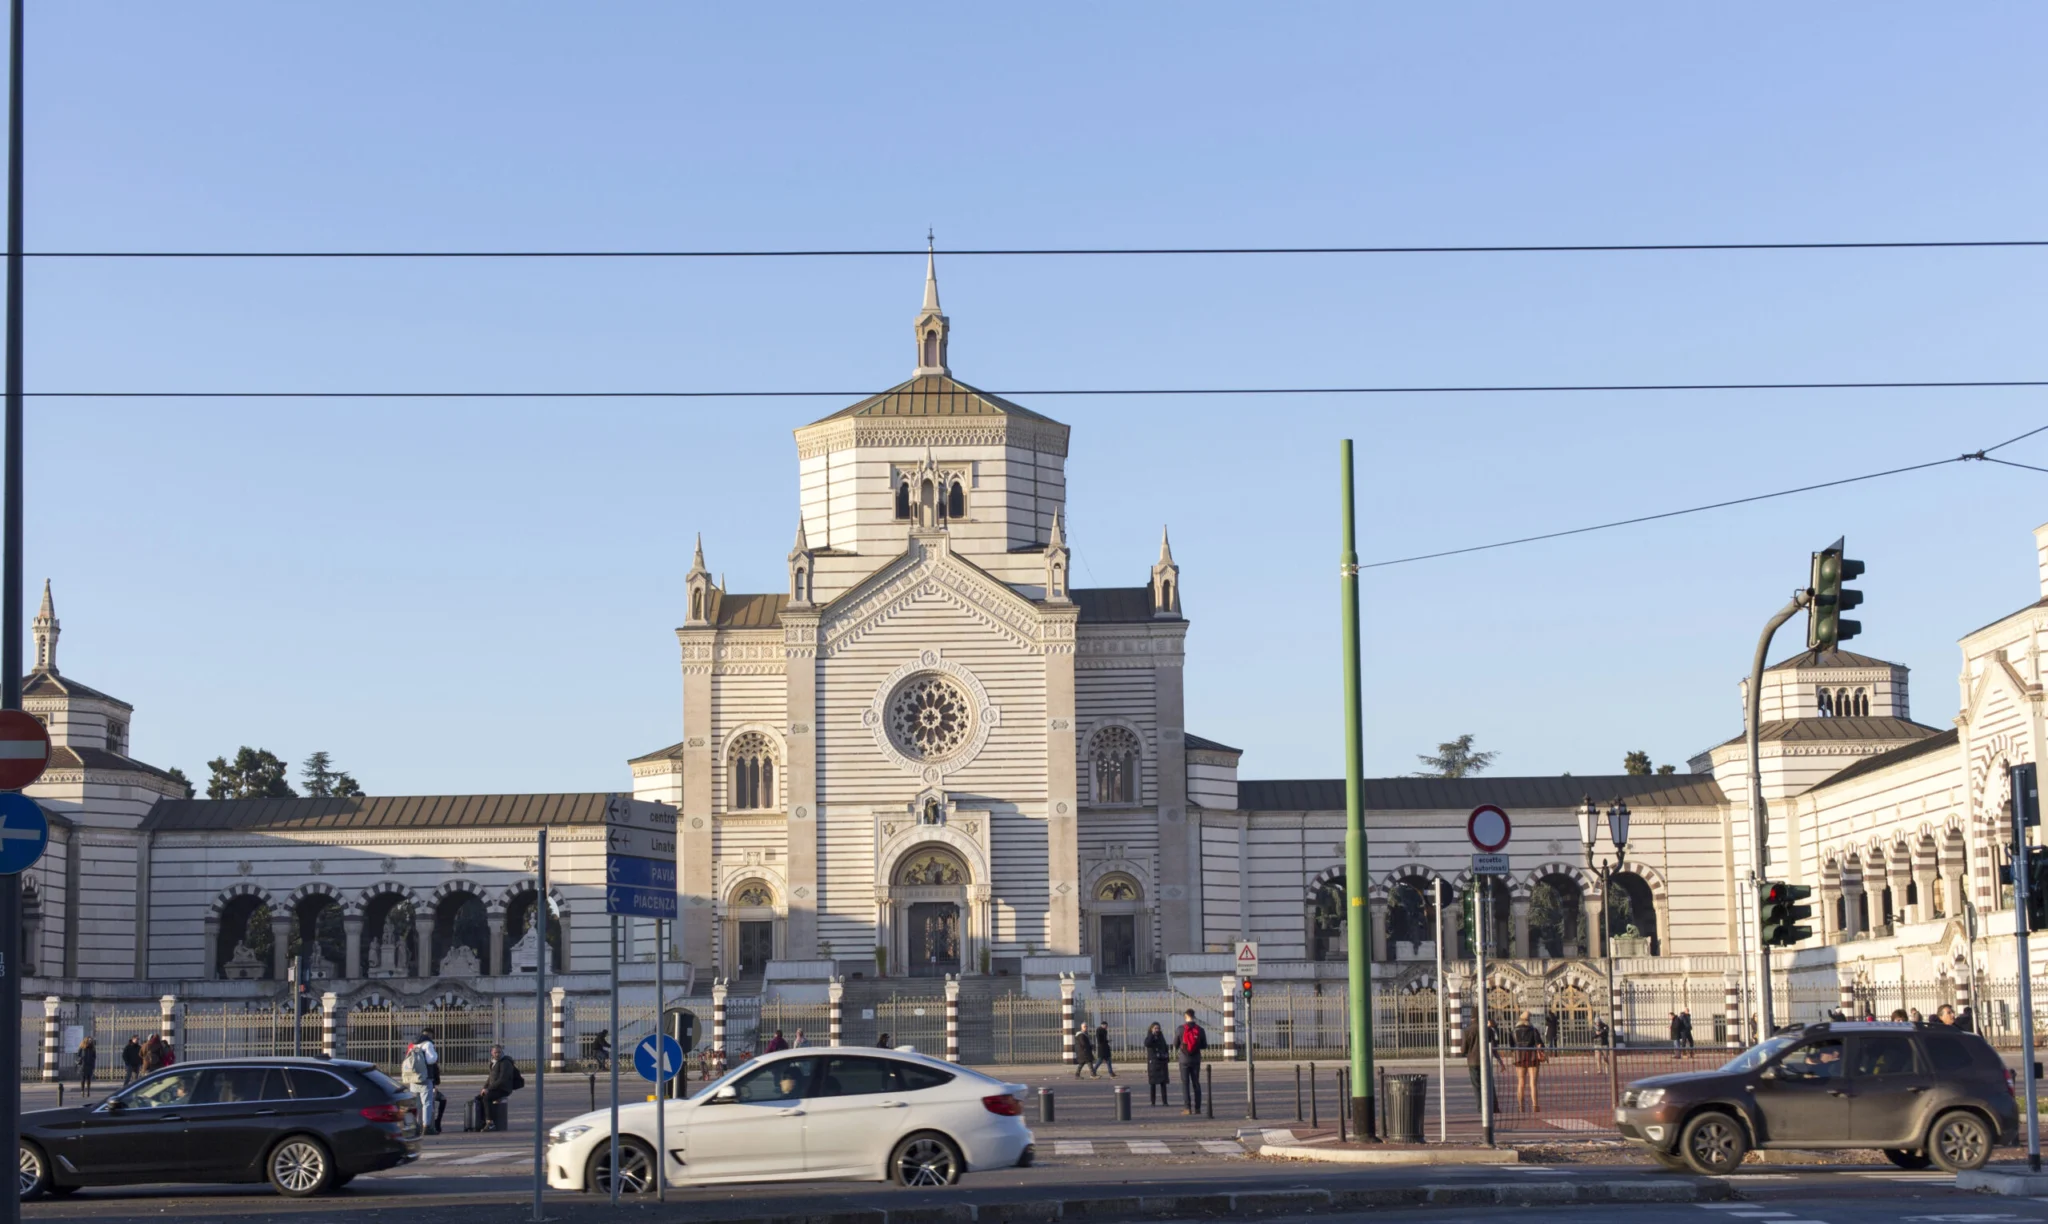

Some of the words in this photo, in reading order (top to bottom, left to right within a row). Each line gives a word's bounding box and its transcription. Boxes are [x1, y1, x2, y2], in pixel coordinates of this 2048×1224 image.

[650, 812, 675, 824] centro
[651, 838, 675, 853] Linate
[651, 867, 675, 882] PAVIA
[633, 894, 676, 911] PIACENZA
